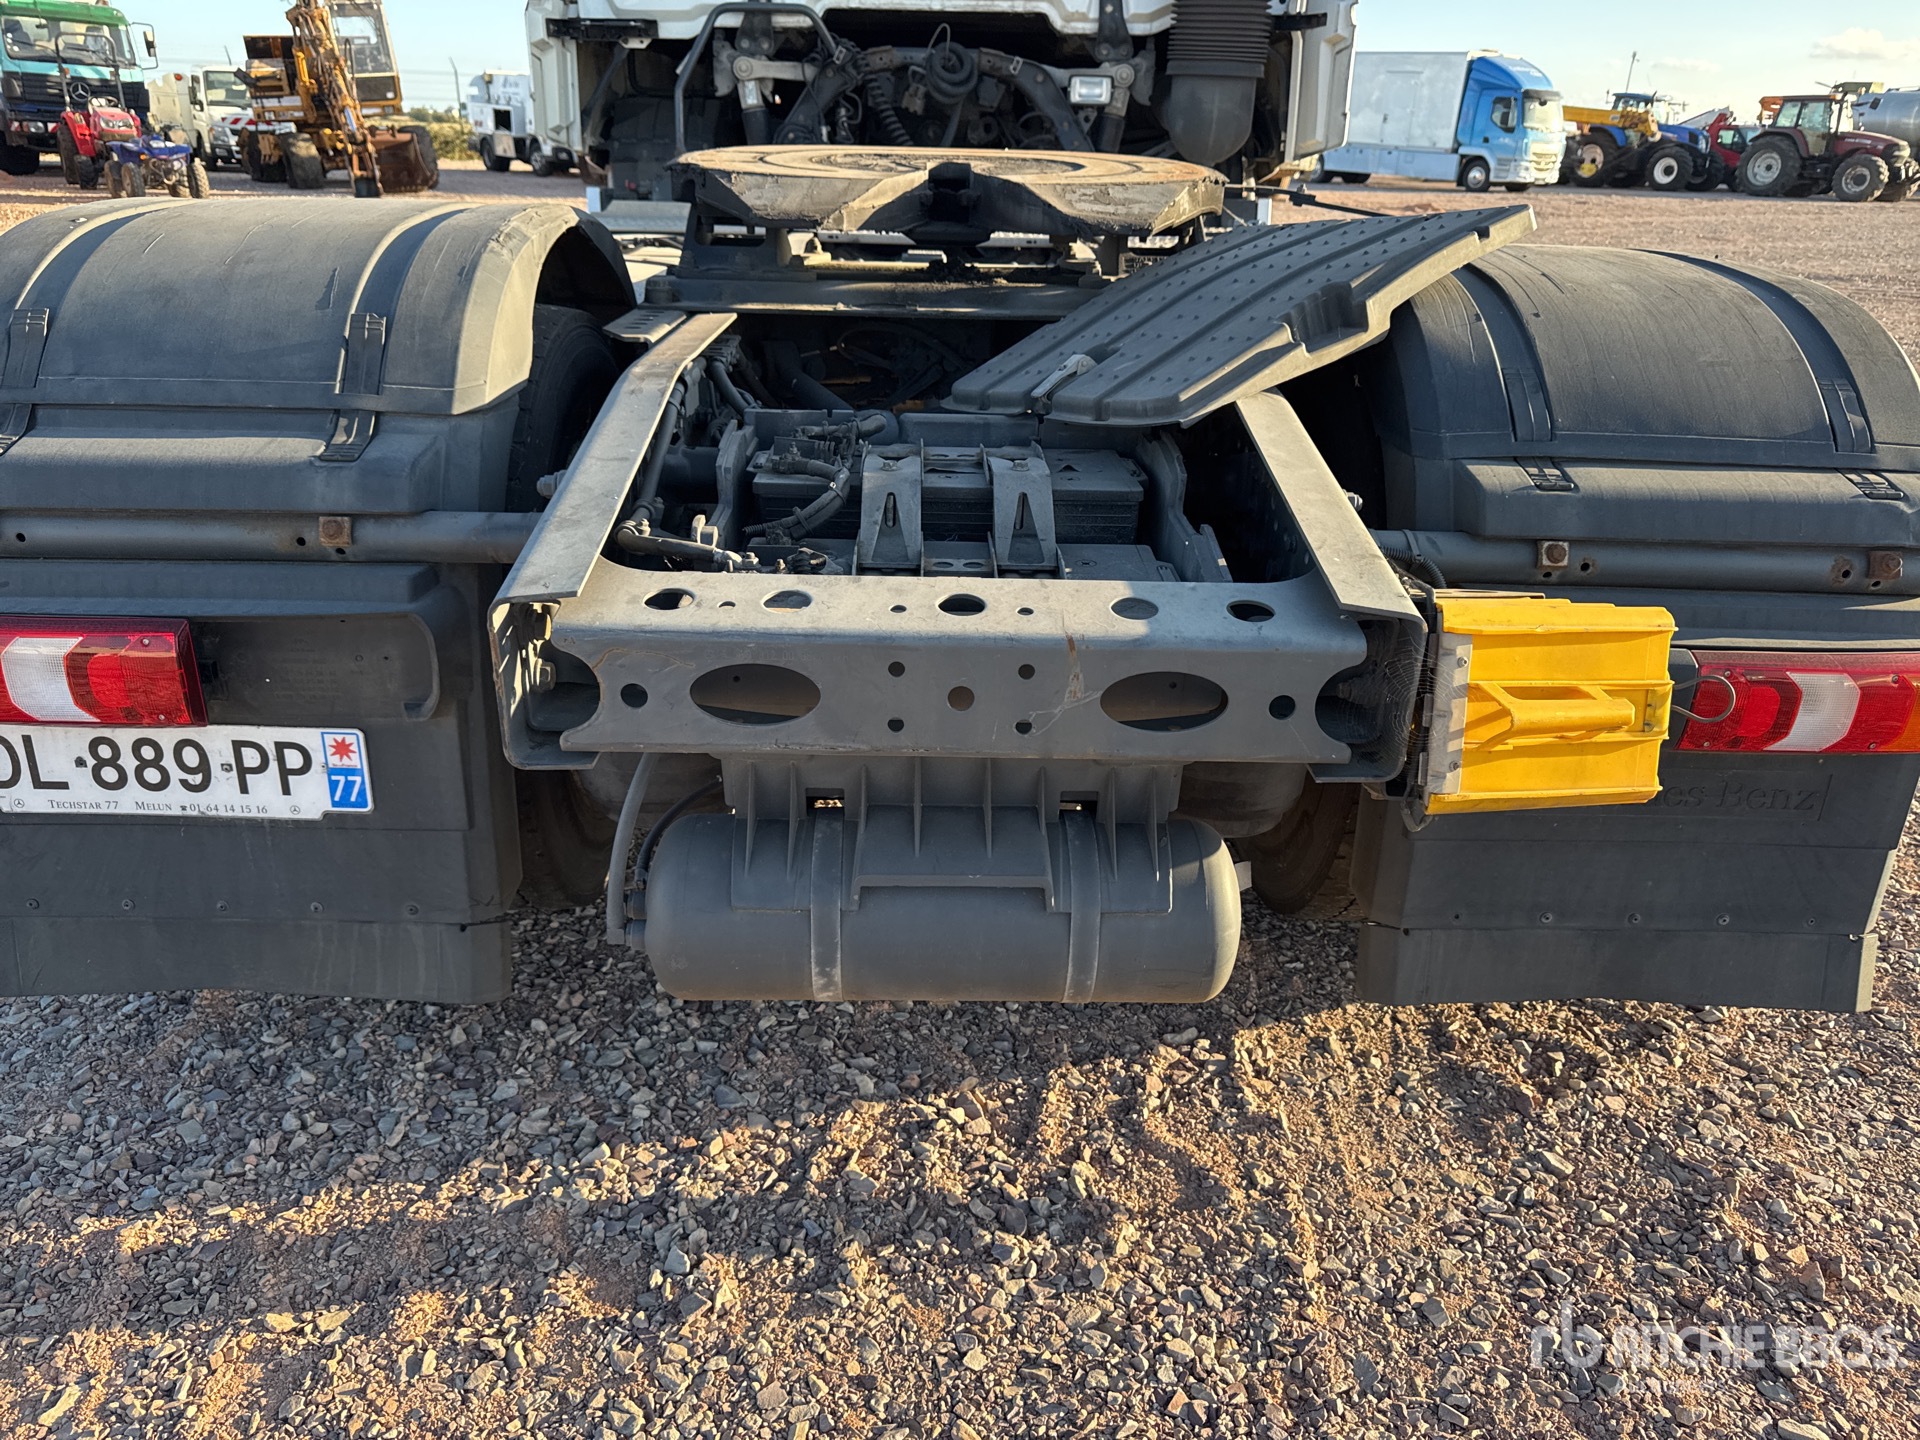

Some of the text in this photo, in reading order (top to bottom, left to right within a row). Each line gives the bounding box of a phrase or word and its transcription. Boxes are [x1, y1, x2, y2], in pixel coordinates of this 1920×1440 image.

[88, 737, 212, 794] 889
[231, 739, 313, 796] PP
[331, 775, 362, 802] 77
[104, 800, 119, 810] 77
[206, 804, 219, 813] 64
[224, 804, 235, 813] 14
[240, 805, 252, 814] 15
[257, 805, 268, 814] 16
